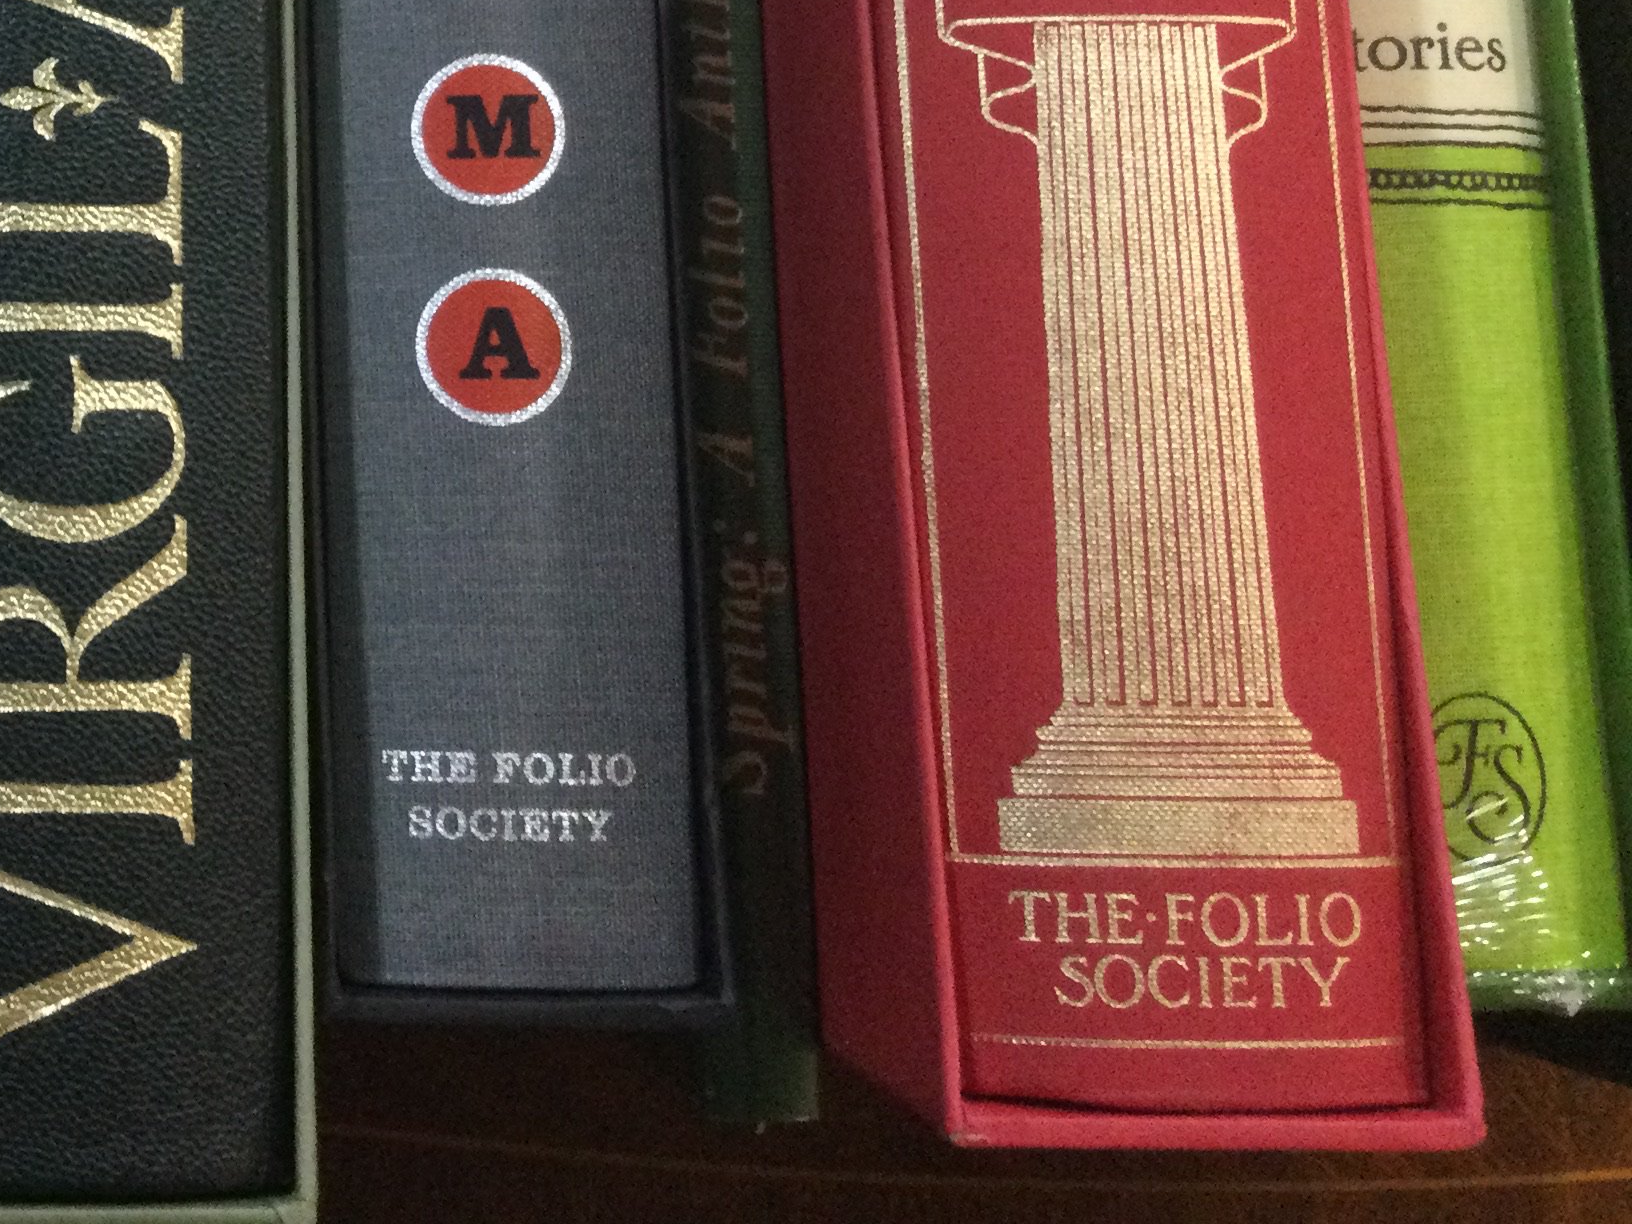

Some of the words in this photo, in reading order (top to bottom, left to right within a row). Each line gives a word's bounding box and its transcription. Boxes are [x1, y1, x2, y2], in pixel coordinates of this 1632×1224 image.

[381, 749, 477, 783] THE
[492, 752, 637, 787] FOLIO
[408, 805, 613, 842] SOCIETY
[1054, 954, 1351, 1008] SOCIETY
